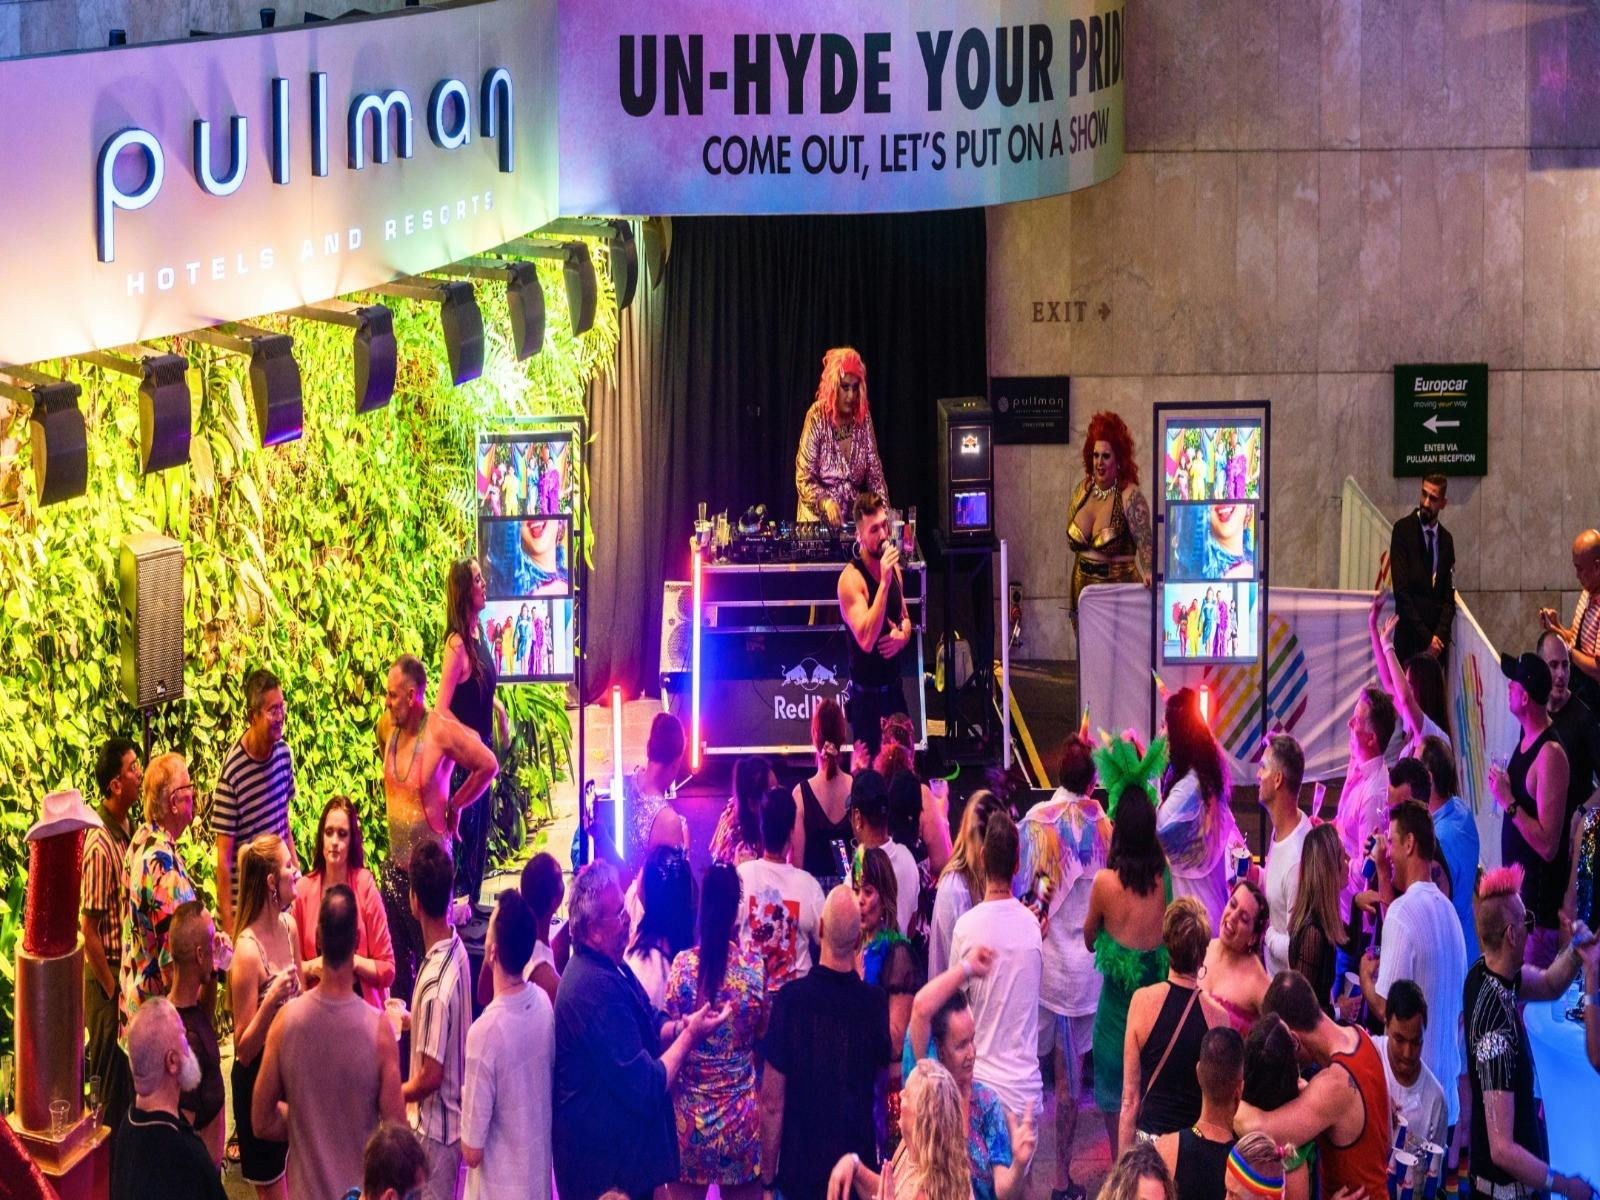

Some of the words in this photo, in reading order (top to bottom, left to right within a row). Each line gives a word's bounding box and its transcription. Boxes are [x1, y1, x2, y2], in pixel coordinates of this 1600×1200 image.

[619, 33, 891, 117] UN-HYDE
[916, 24, 1053, 112] YOUR
[1069, 9, 1124, 97] PRID
[702, 135, 791, 176] COME
[802, 134, 872, 180] OUT,
[956, 128, 1001, 169] PUT
[1007, 122, 1043, 164] ON
[1049, 120, 1064, 157] A
[1069, 107, 1109, 155] SHOW
[97, 67, 514, 263] pullman
[127, 248, 274, 296] HOTELS
[303, 228, 362, 261] AND
[385, 191, 494, 241] RESORTS
[1032, 301, 1087, 322] EXIT
[1414, 377, 1468, 396] Europcar
[1413, 400, 1437, 409] moving
[1454, 400, 1467, 408] way
[1406, 454, 1437, 463] PULLMAN
[1439, 453, 1476, 462] RECEPTION
[1424, 443, 1446, 452] ENTER
[1446, 443, 1458, 451] VIA
[774, 694, 809, 719] Red
